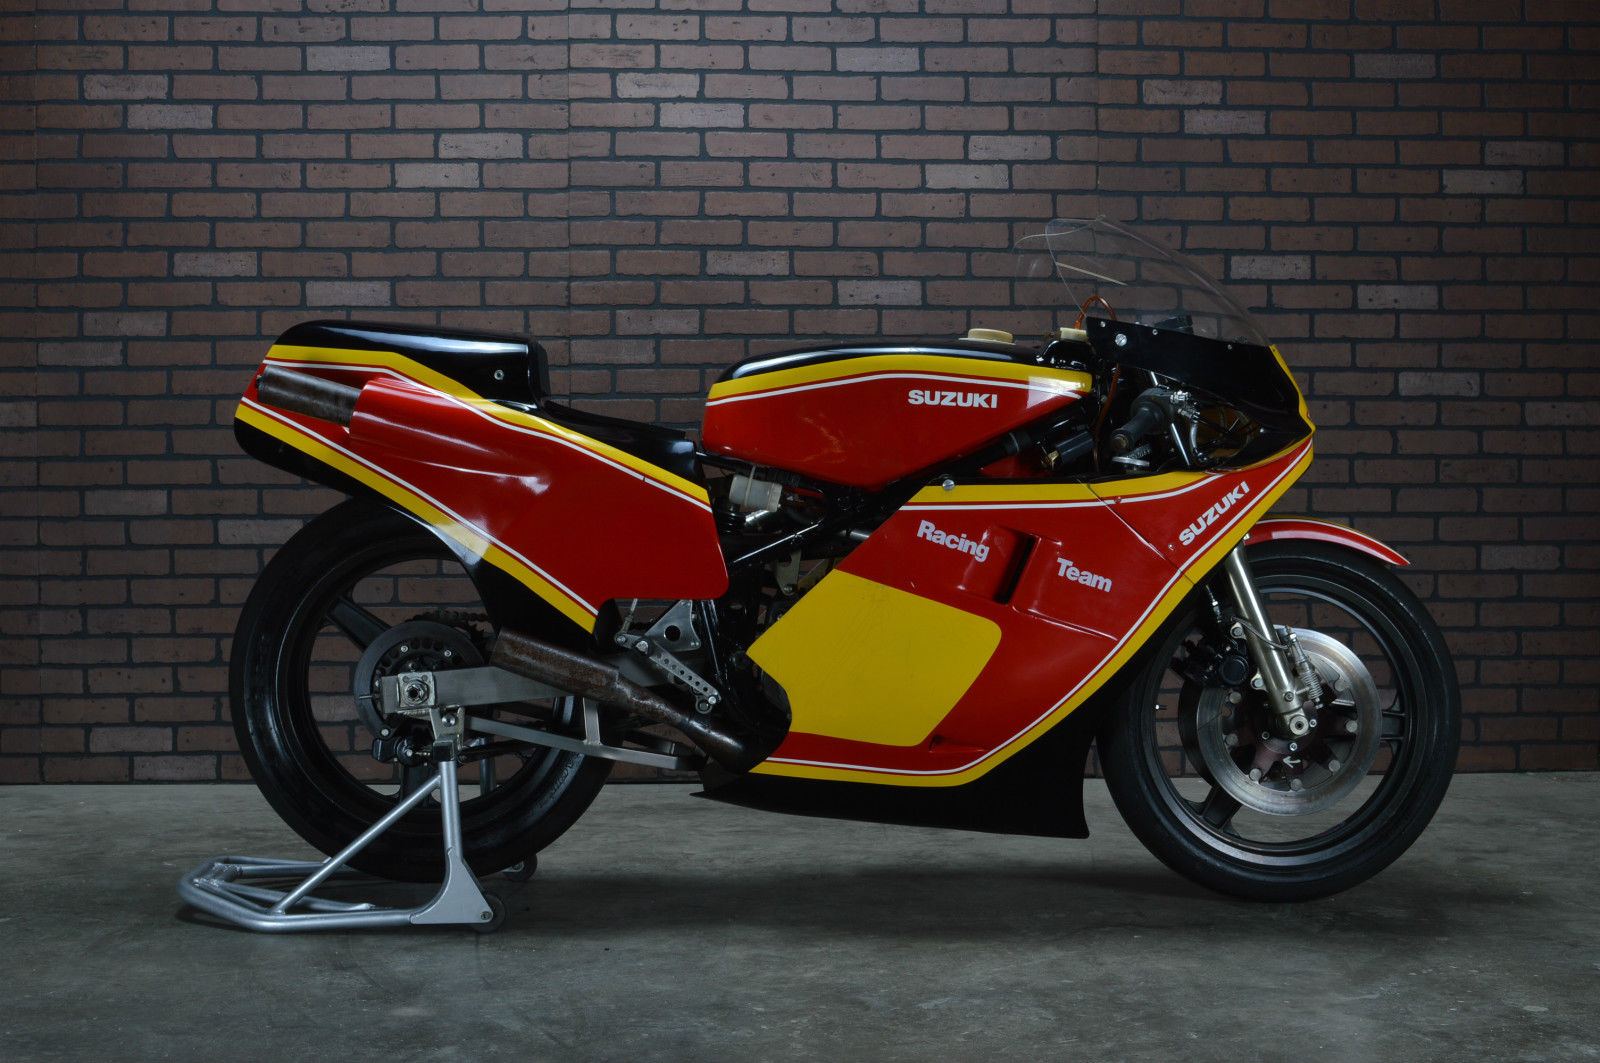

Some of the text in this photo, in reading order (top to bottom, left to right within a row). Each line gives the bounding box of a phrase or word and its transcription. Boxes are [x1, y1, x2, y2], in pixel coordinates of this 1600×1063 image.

[907, 389, 998, 409] SUZUKI
[1179, 480, 1250, 546] SUZUKI
[916, 519, 1113, 593] Racing Team
